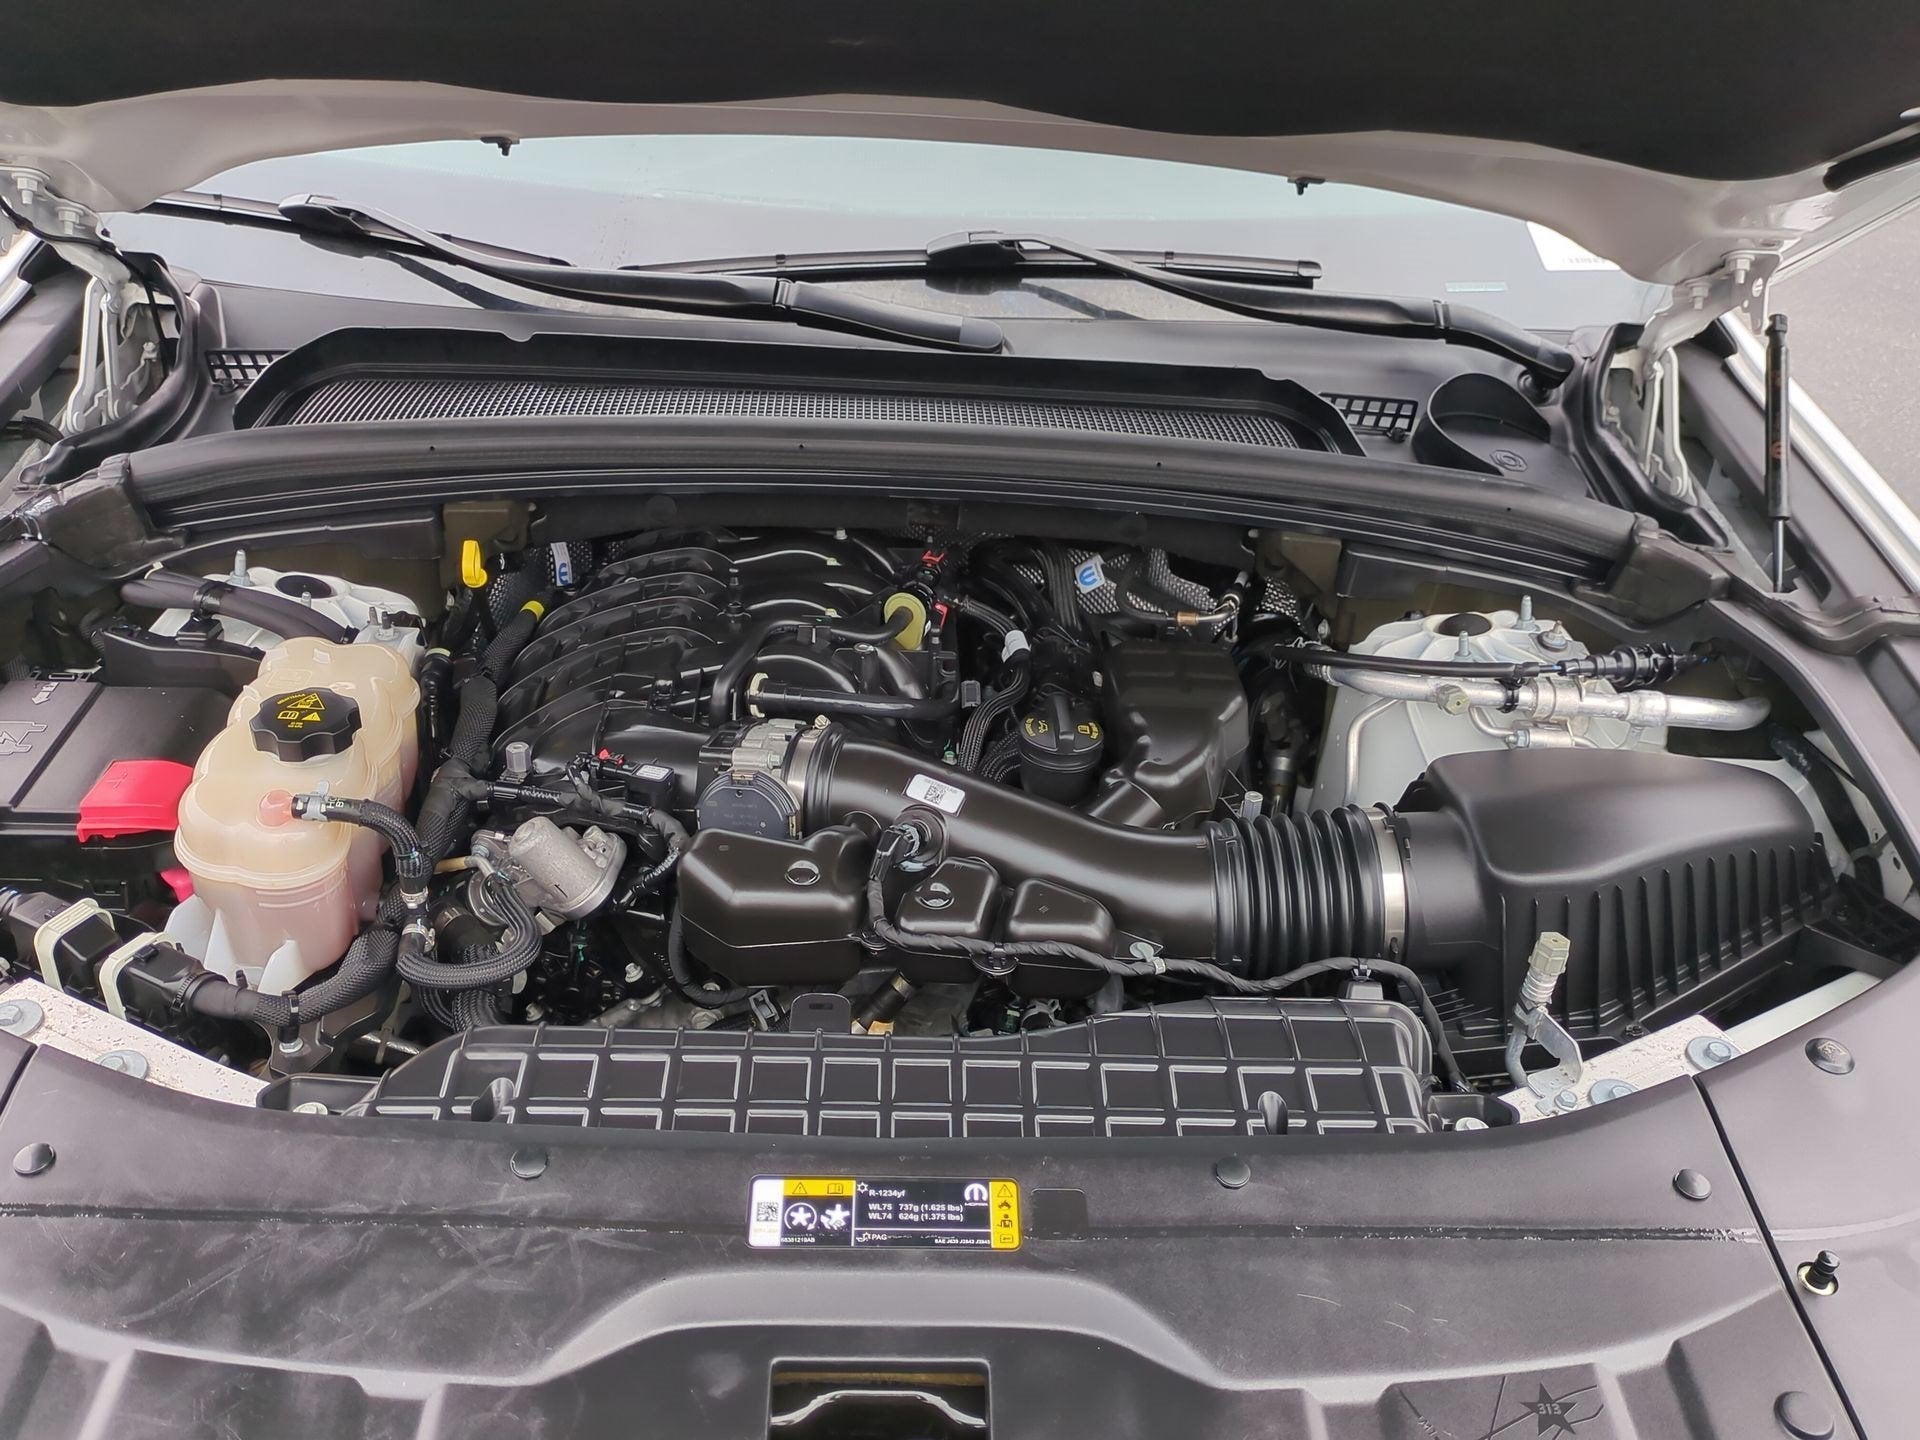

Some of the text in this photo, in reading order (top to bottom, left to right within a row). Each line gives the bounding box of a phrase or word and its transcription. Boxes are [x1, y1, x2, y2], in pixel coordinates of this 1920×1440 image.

[868, 1189, 906, 1199] R-1234yf
[868, 1203, 964, 1212] WL75 737g (1.625 lbs)
[868, 1212, 964, 1222] WL74 624g (1.375 lbs)
[872, 1233, 887, 1241] PAG
[1537, 1403, 1562, 1415] 313
